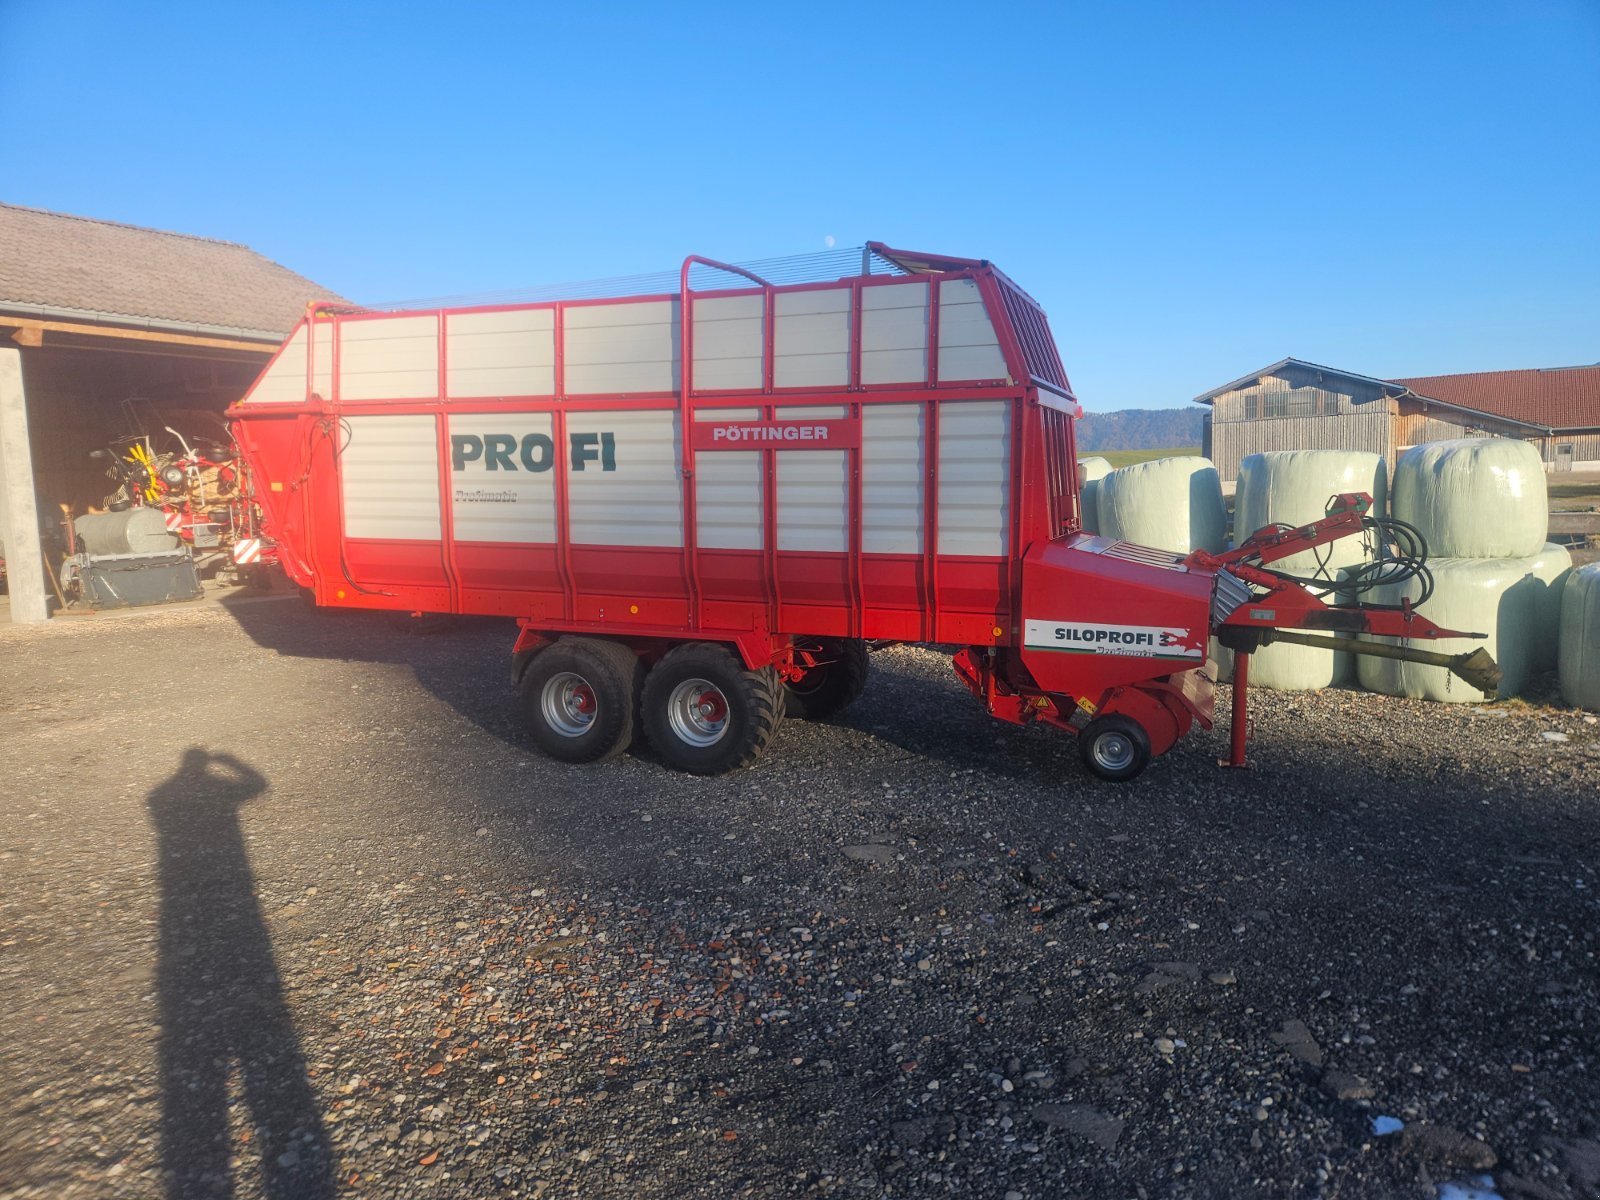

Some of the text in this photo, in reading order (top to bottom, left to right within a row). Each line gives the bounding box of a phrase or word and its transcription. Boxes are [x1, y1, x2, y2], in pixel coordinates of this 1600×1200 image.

[713, 425, 828, 441] PÖTTINGER
[451, 432, 616, 472] PROFI
[1055, 627, 1153, 646] SILOPROFI
